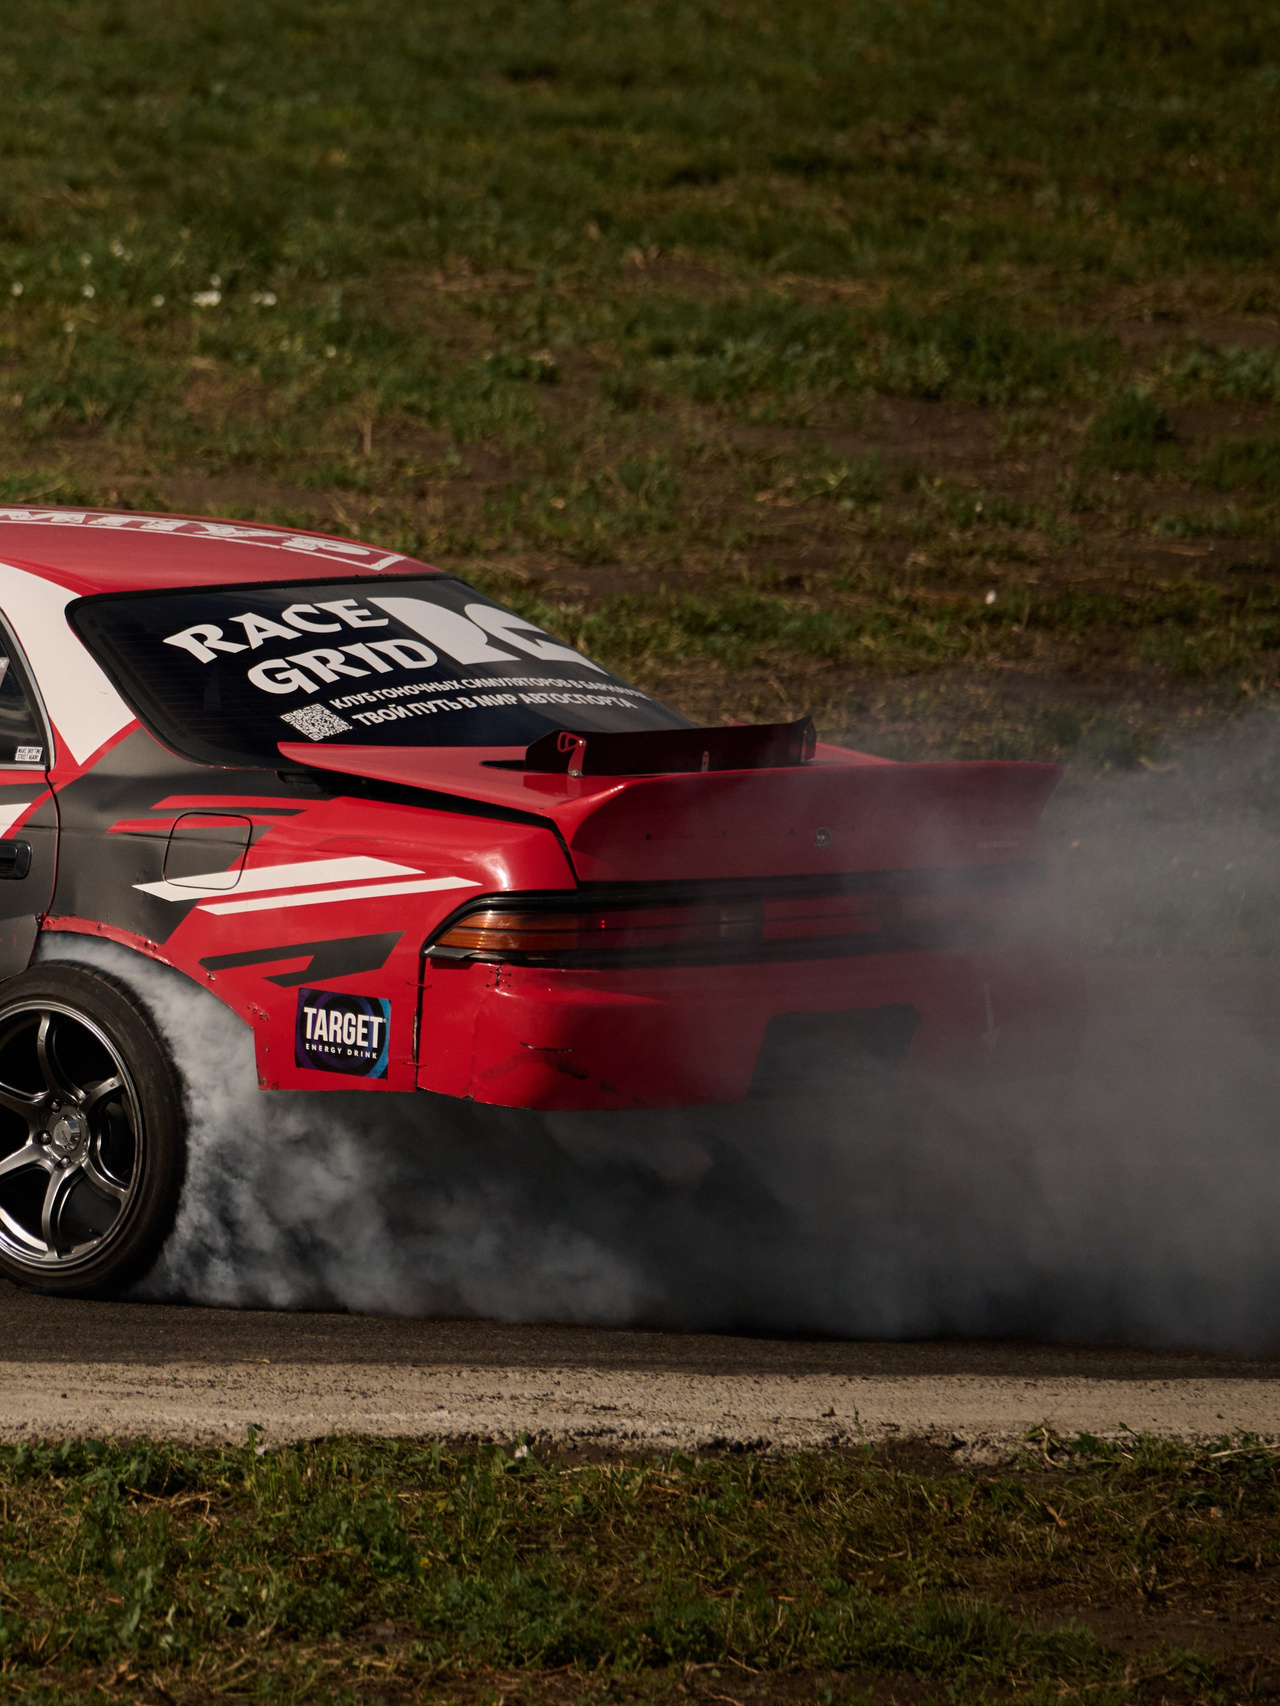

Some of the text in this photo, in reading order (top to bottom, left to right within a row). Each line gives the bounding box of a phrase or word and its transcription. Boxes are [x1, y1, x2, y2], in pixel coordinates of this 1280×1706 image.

[163, 598, 390, 664] RACE
[247, 638, 438, 695] GRID
[329, 692, 378, 710] КЛУБ
[373, 680, 466, 701] ГОНОЧНЫХ
[461, 677, 572, 689] СИМУЛЯТОРОВ
[351, 692, 639, 726] ТВОЙ ПУТЬ В МИР АВТОСПОРТА
[303, 1006, 383, 1048] TARGET
[305, 1043, 378, 1060] ENERGY DRINK
